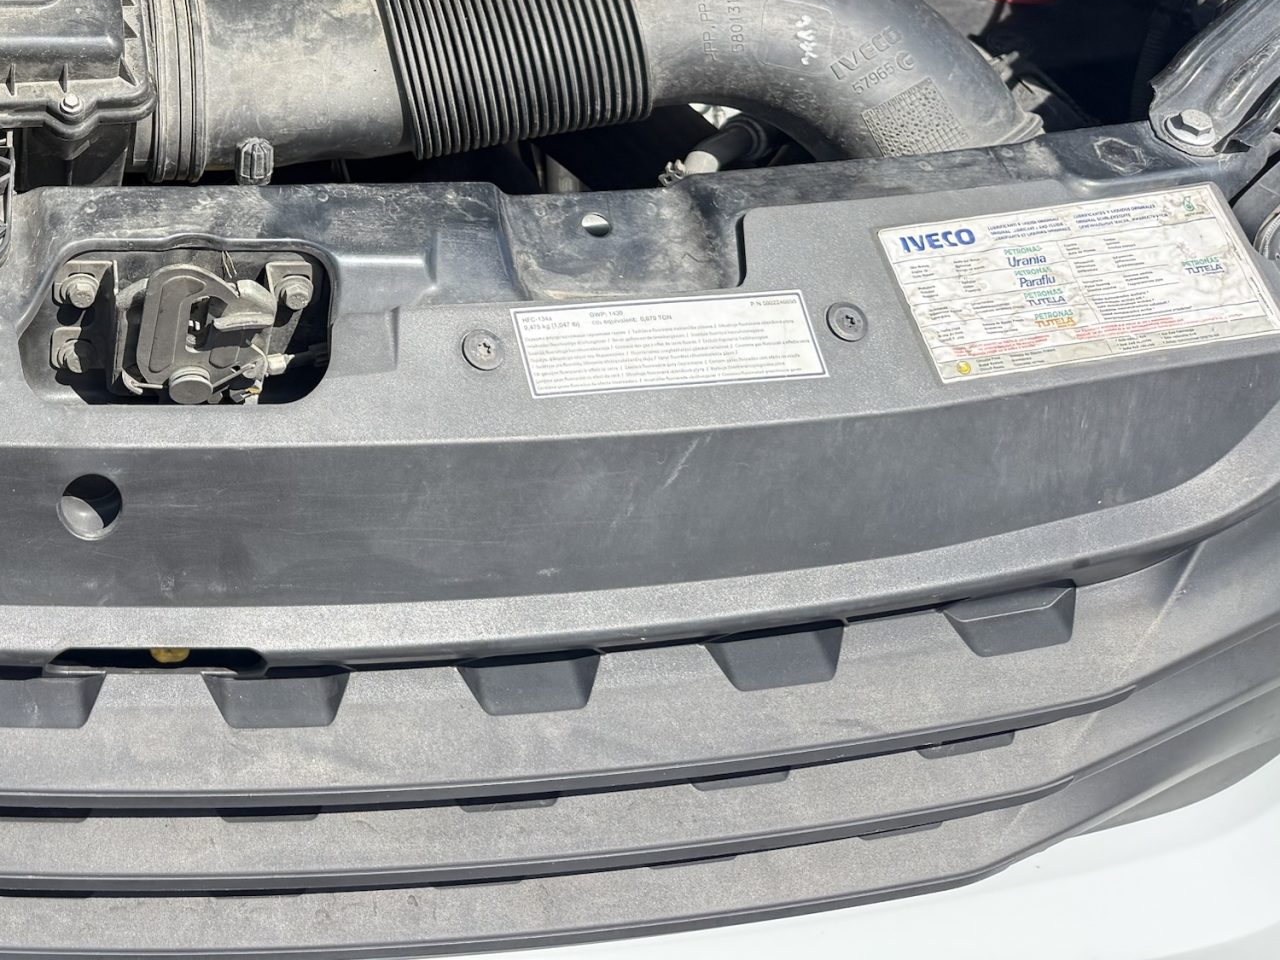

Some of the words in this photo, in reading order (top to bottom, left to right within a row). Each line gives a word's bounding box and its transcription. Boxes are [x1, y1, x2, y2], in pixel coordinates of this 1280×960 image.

[830, 25, 903, 80] IVECO
[852, 61, 895, 94] 57965
[899, 229, 976, 253] IVECO
[1003, 244, 1043, 256] PETRONAS
[1006, 252, 1047, 268] Urania
[1181, 256, 1221, 268] PETRONAS
[1013, 266, 1052, 277] PETRONAS
[1185, 263, 1223, 274] TUTELA
[1019, 273, 1056, 289] Paraflu
[1023, 288, 1064, 300] PETRONAS
[1034, 309, 1074, 320] PETRONAS
